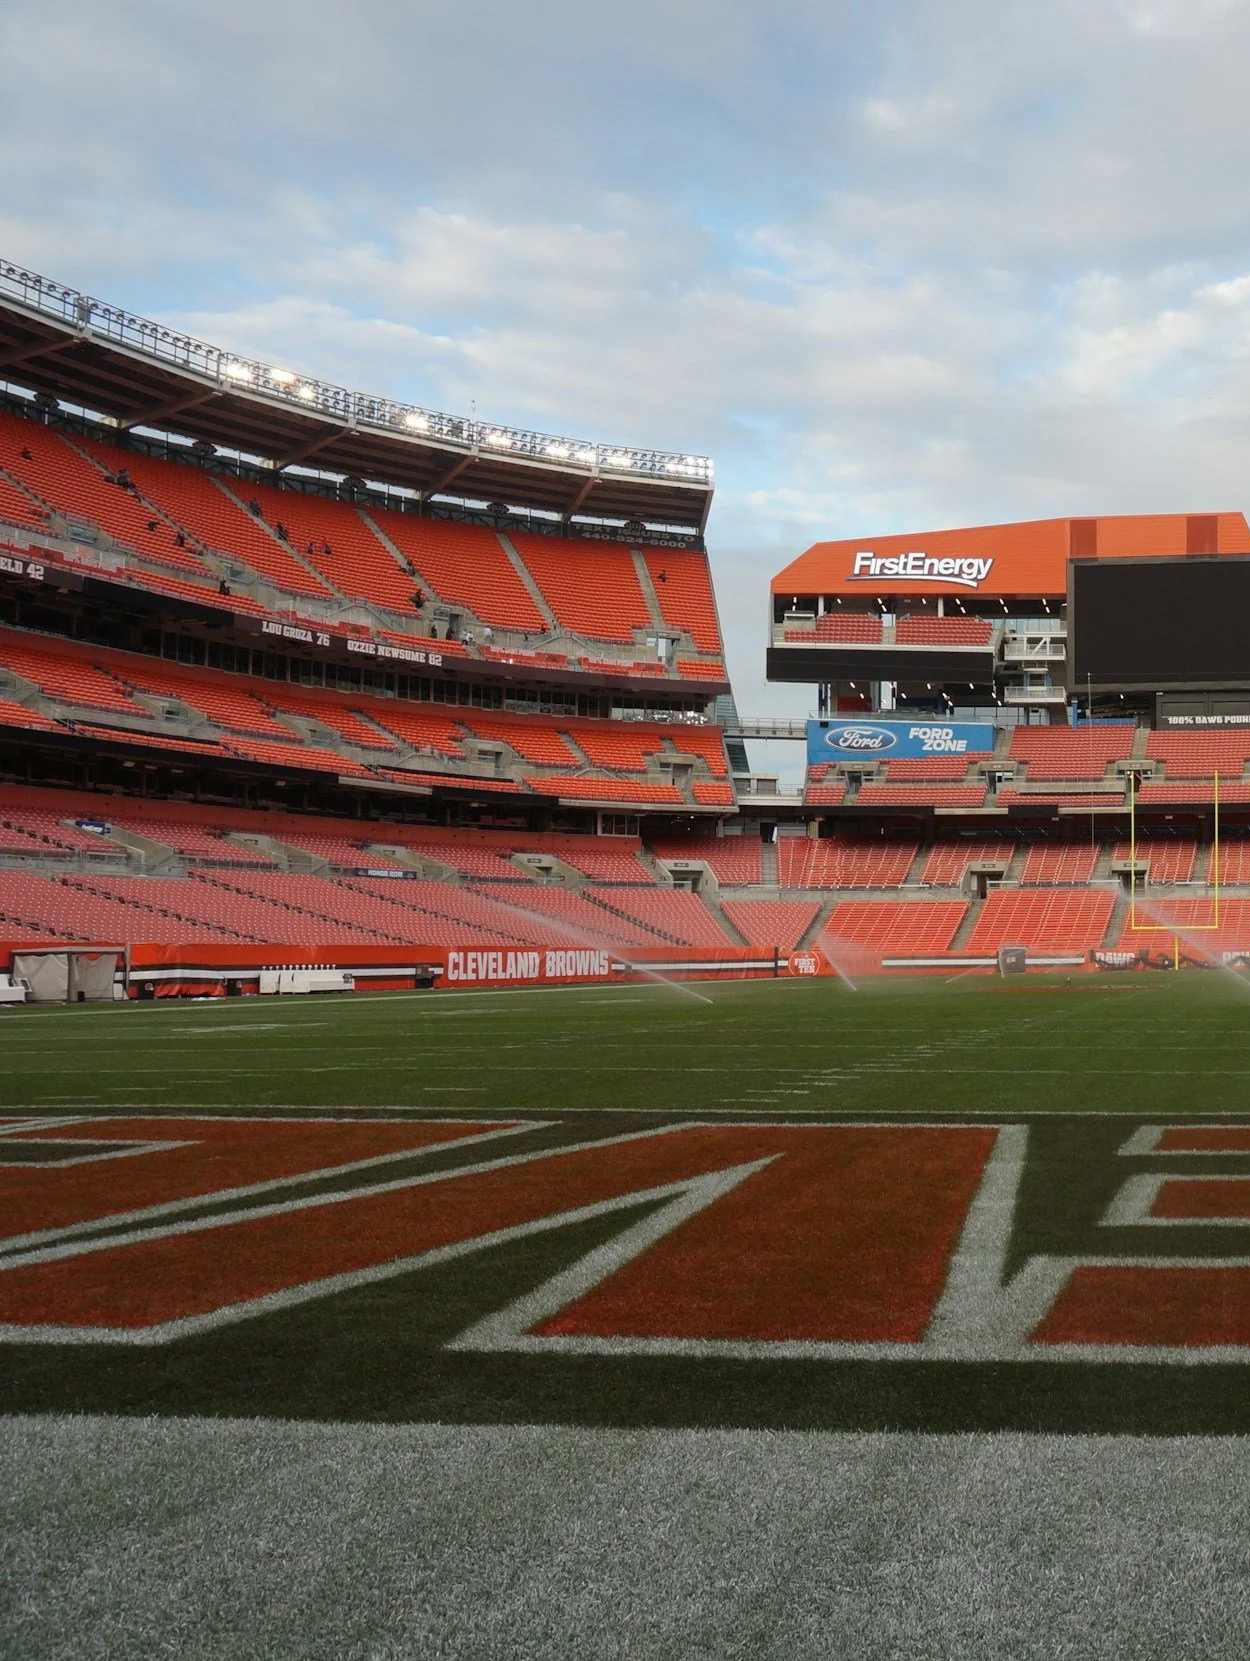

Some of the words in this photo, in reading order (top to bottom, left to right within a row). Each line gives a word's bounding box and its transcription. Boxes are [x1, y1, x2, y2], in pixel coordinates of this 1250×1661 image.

[576, 524, 613, 533] TEXT
[618, 528, 671, 540] ISSUES
[676, 534, 695, 542] TO
[26, 564, 45, 580] 42
[853, 552, 994, 580] FirstEnergy
[262, 621, 282, 635] LOU
[283, 626, 313, 643] GROZA
[317, 633, 330, 647] 76
[347, 640, 376, 655] OZZIE
[377, 645, 426, 663] NEWSOME
[428, 653, 442, 667] 82
[1168, 716, 1194, 724] 100%
[1195, 715, 1223, 724] DAWG
[839, 727, 883, 748] Ford
[909, 727, 953, 740] FORD
[922, 739, 968, 752] ZONE
[368, 869, 388, 878] HONOR
[448, 952, 540, 980] CLEVELAND
[545, 950, 609, 977] BROWNS
[794, 958, 816, 967] FIRST
[798, 966, 816, 974] TEN
